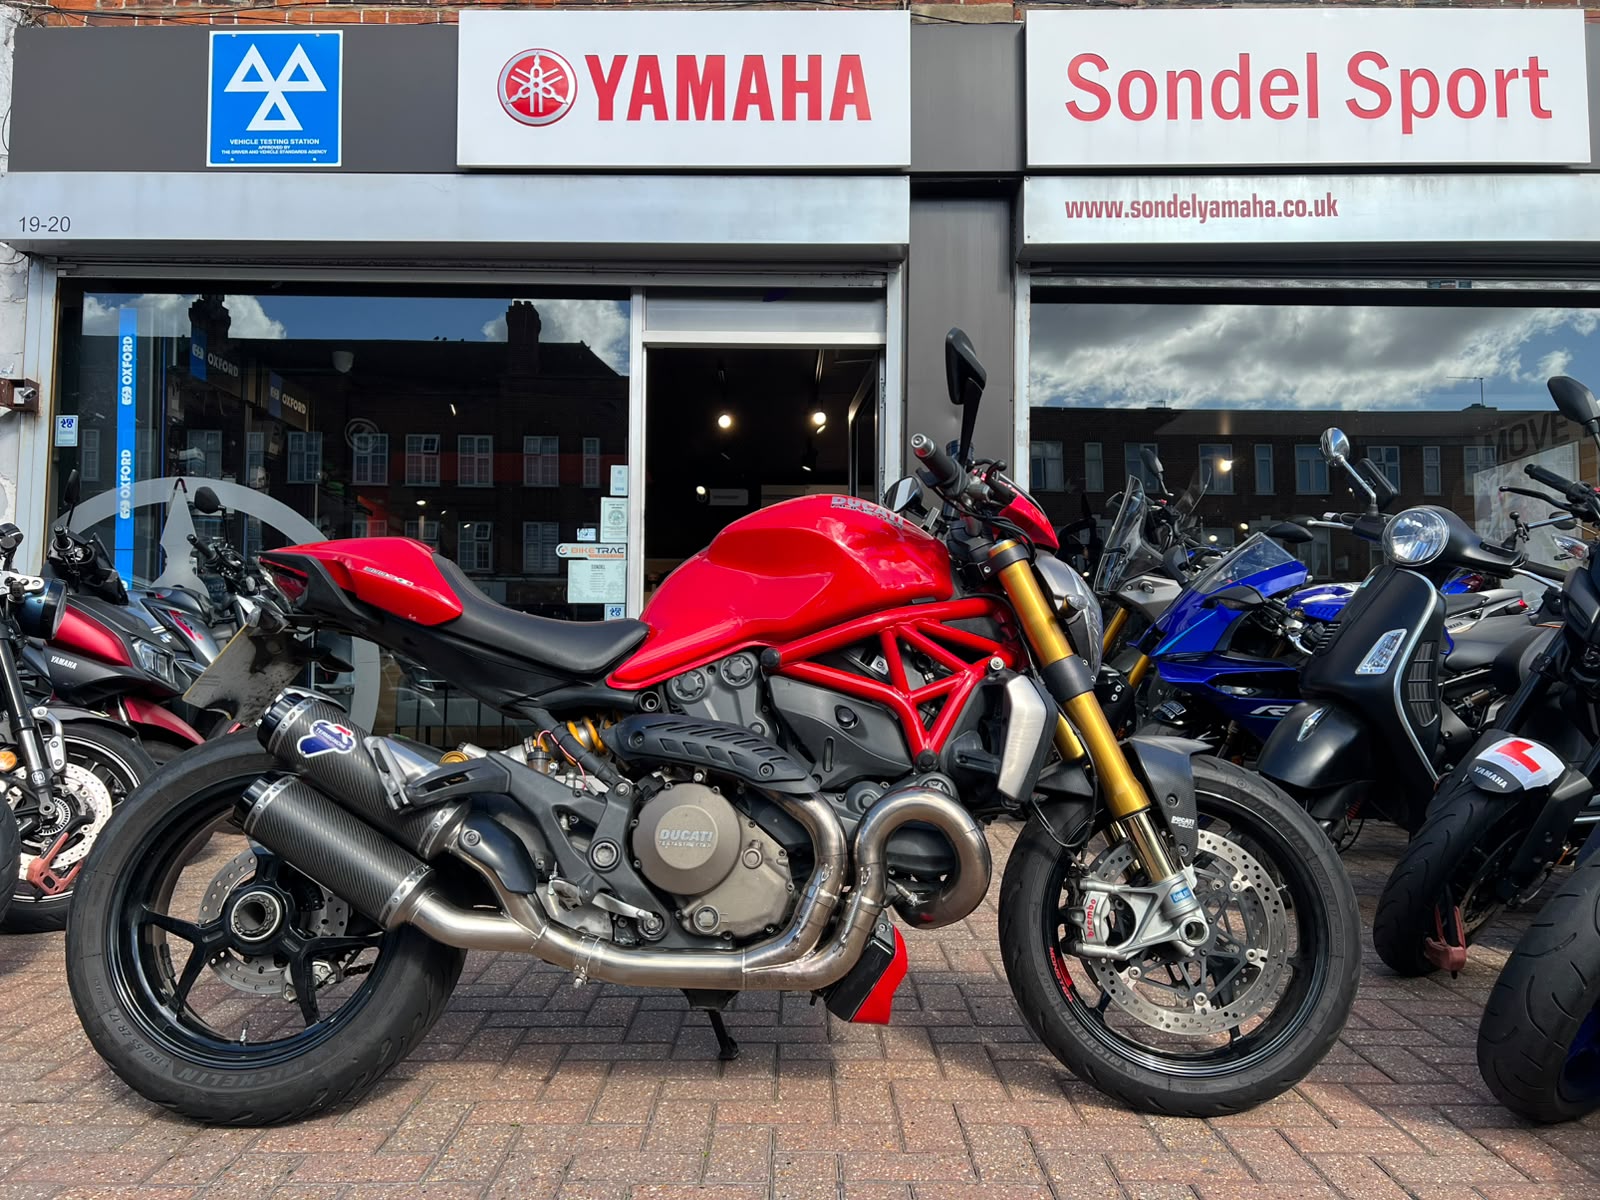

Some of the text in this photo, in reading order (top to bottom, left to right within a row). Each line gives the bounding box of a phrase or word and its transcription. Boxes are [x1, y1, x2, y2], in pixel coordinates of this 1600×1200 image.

[584, 54, 872, 121] YAMAHA
[1065, 50, 1552, 135] Sondel Sport
[19, 216, 71, 232] 19-20
[1065, 192, 1338, 224] www.sondelyamaha.co.uk
[122, 336, 133, 385] OXFORD
[208, 353, 239, 377] OXFORD
[282, 393, 306, 414] OXFORD
[1485, 411, 1569, 463] MOVE
[120, 449, 131, 499] OXFORD
[831, 496, 904, 525] DUCATI
[51, 656, 78, 670] YAMAHA
[1474, 766, 1508, 789] YAMAHA
[660, 830, 713, 841] DUCATI
[1171, 816, 1195, 826] DUCATI
[1086, 899, 1097, 939] brembo
[1049, 946, 1073, 1003] MONSTER
[109, 1013, 163, 1065] 190/55 ZR 17
[1062, 1011, 1123, 1066] MICHELIN
[177, 1061, 304, 1088] MICHELIN
